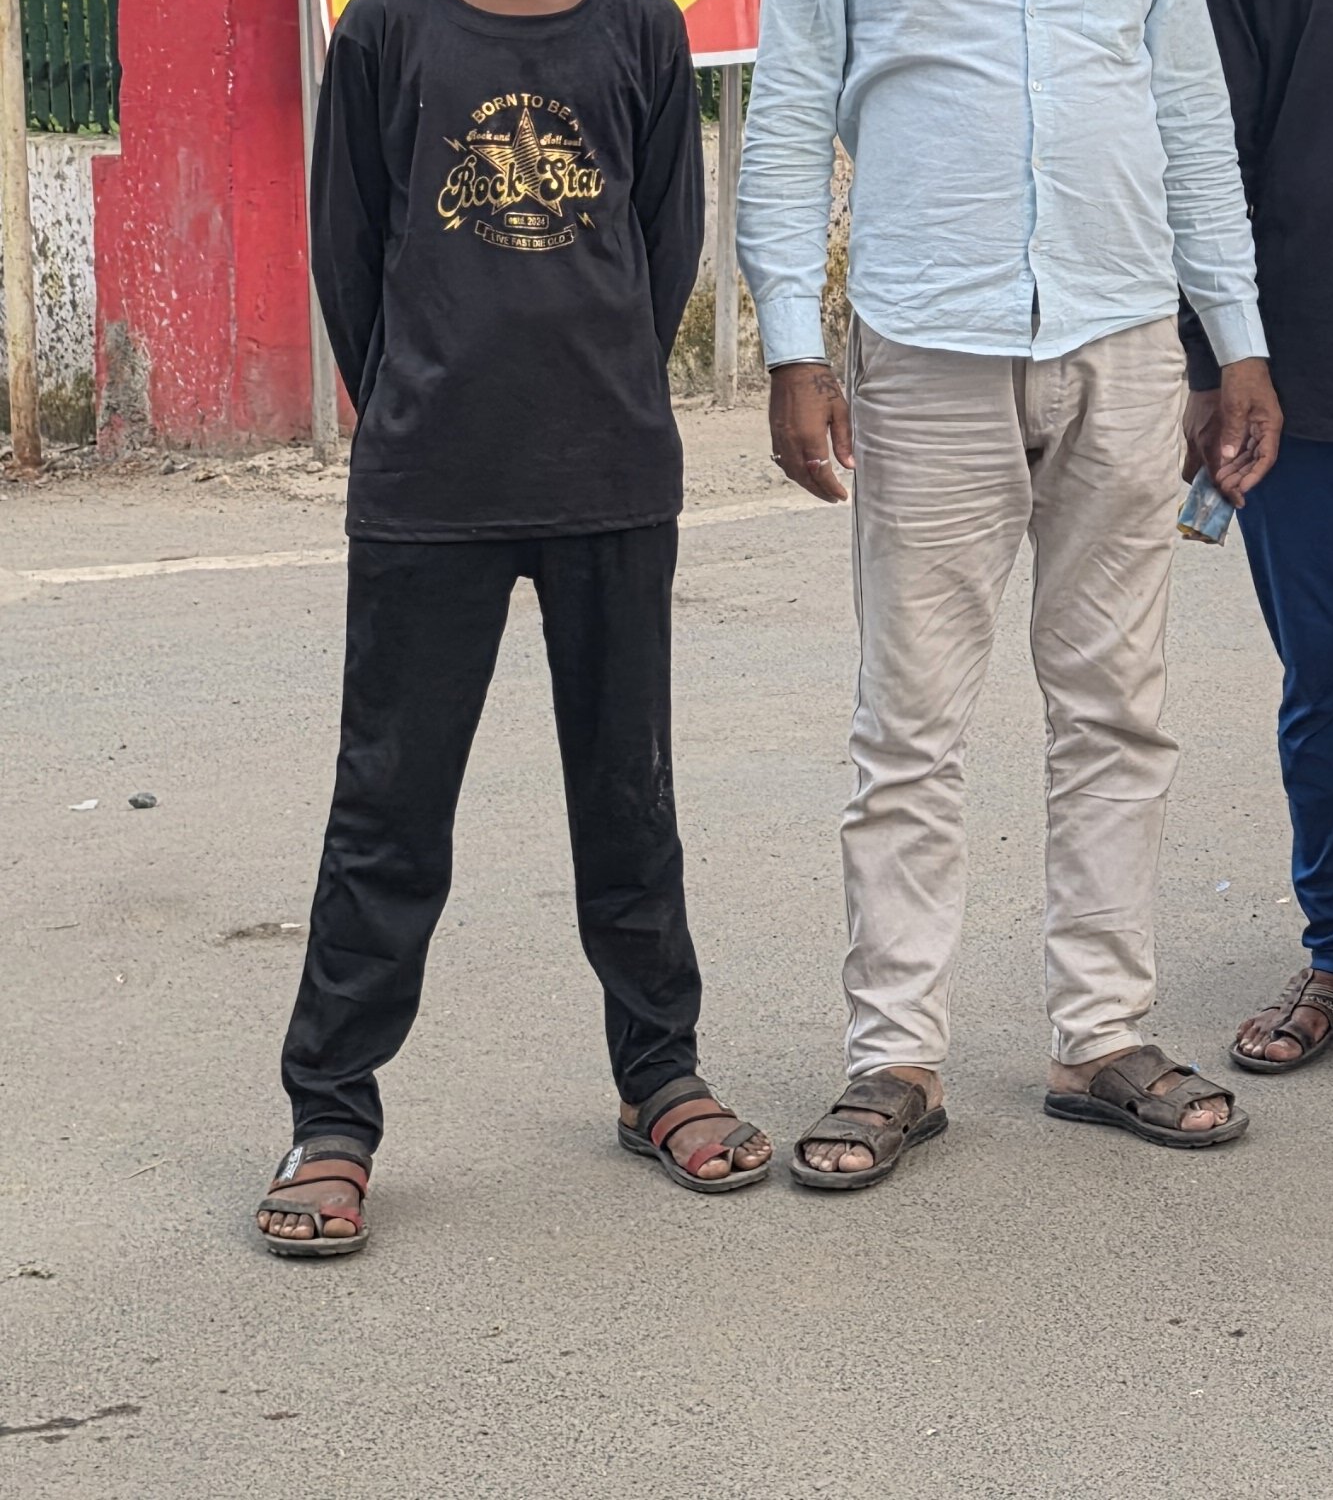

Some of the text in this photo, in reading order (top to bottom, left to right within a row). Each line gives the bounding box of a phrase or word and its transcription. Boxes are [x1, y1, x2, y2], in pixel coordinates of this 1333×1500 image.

[471, 93, 518, 124] BORN
[521, 93, 544, 108] TO
[547, 100, 571, 120] BE
[437, 154, 526, 218] Rock
[527, 214, 546, 227] 2024
[491, 232, 566, 248] LIVE FAST DIE OLD
